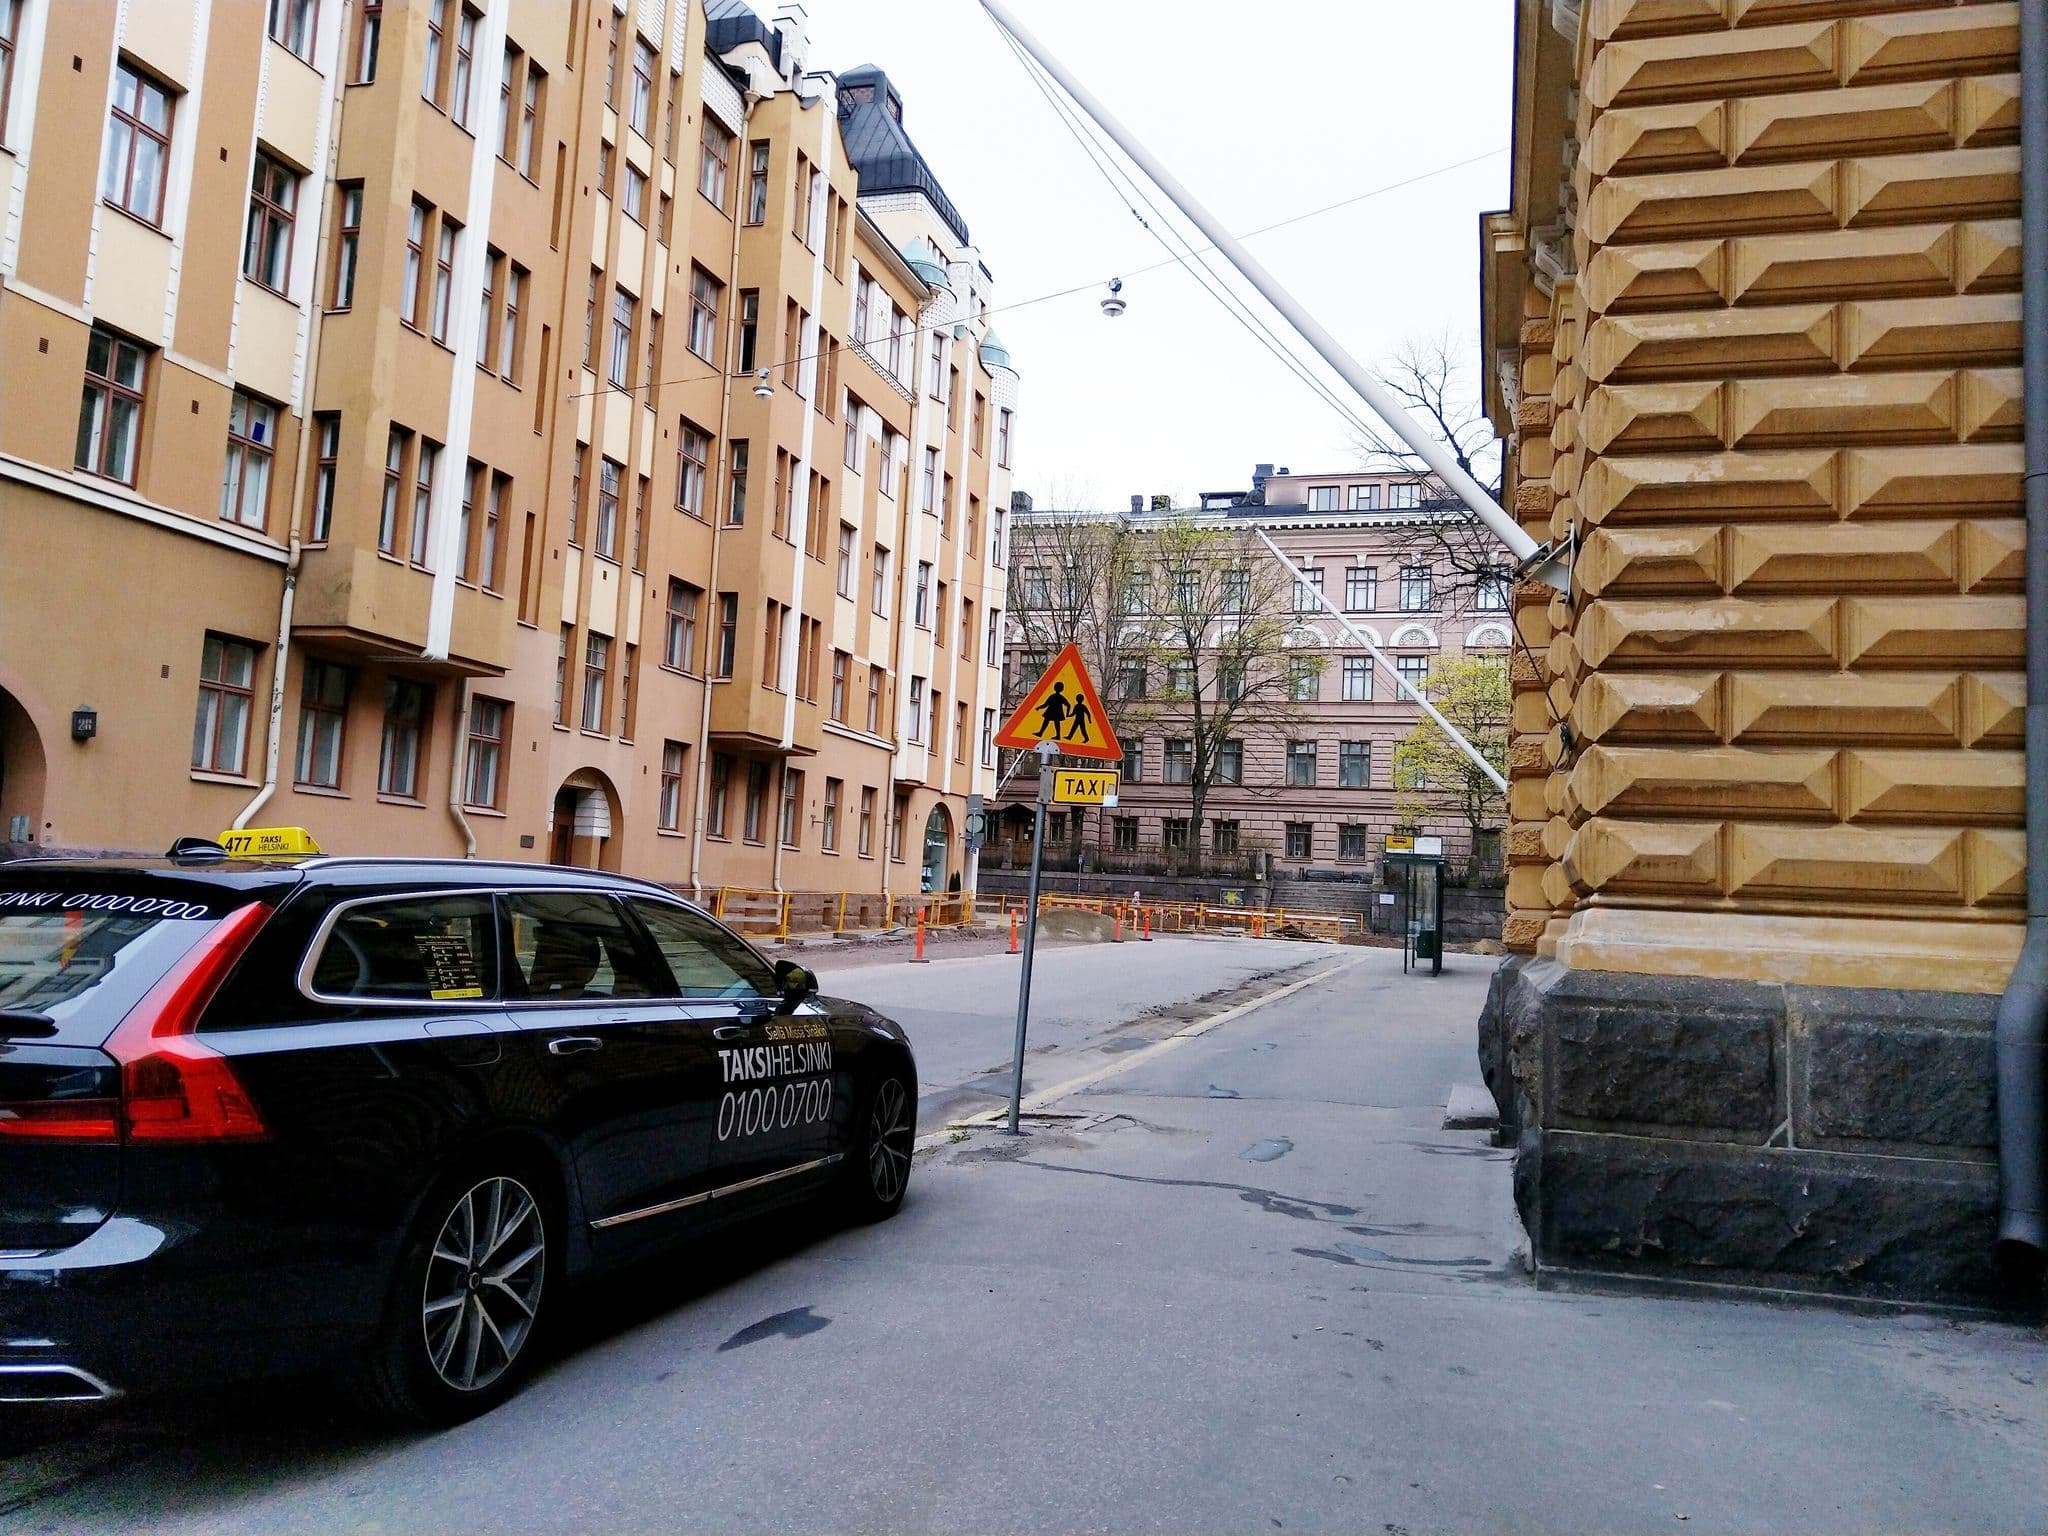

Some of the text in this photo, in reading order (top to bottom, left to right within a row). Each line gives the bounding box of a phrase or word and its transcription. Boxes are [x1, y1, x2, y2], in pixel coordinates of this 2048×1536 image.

[1065, 778, 1105, 796] TAXI
[225, 836, 252, 852] 477
[259, 843, 289, 851] HELSINKI
